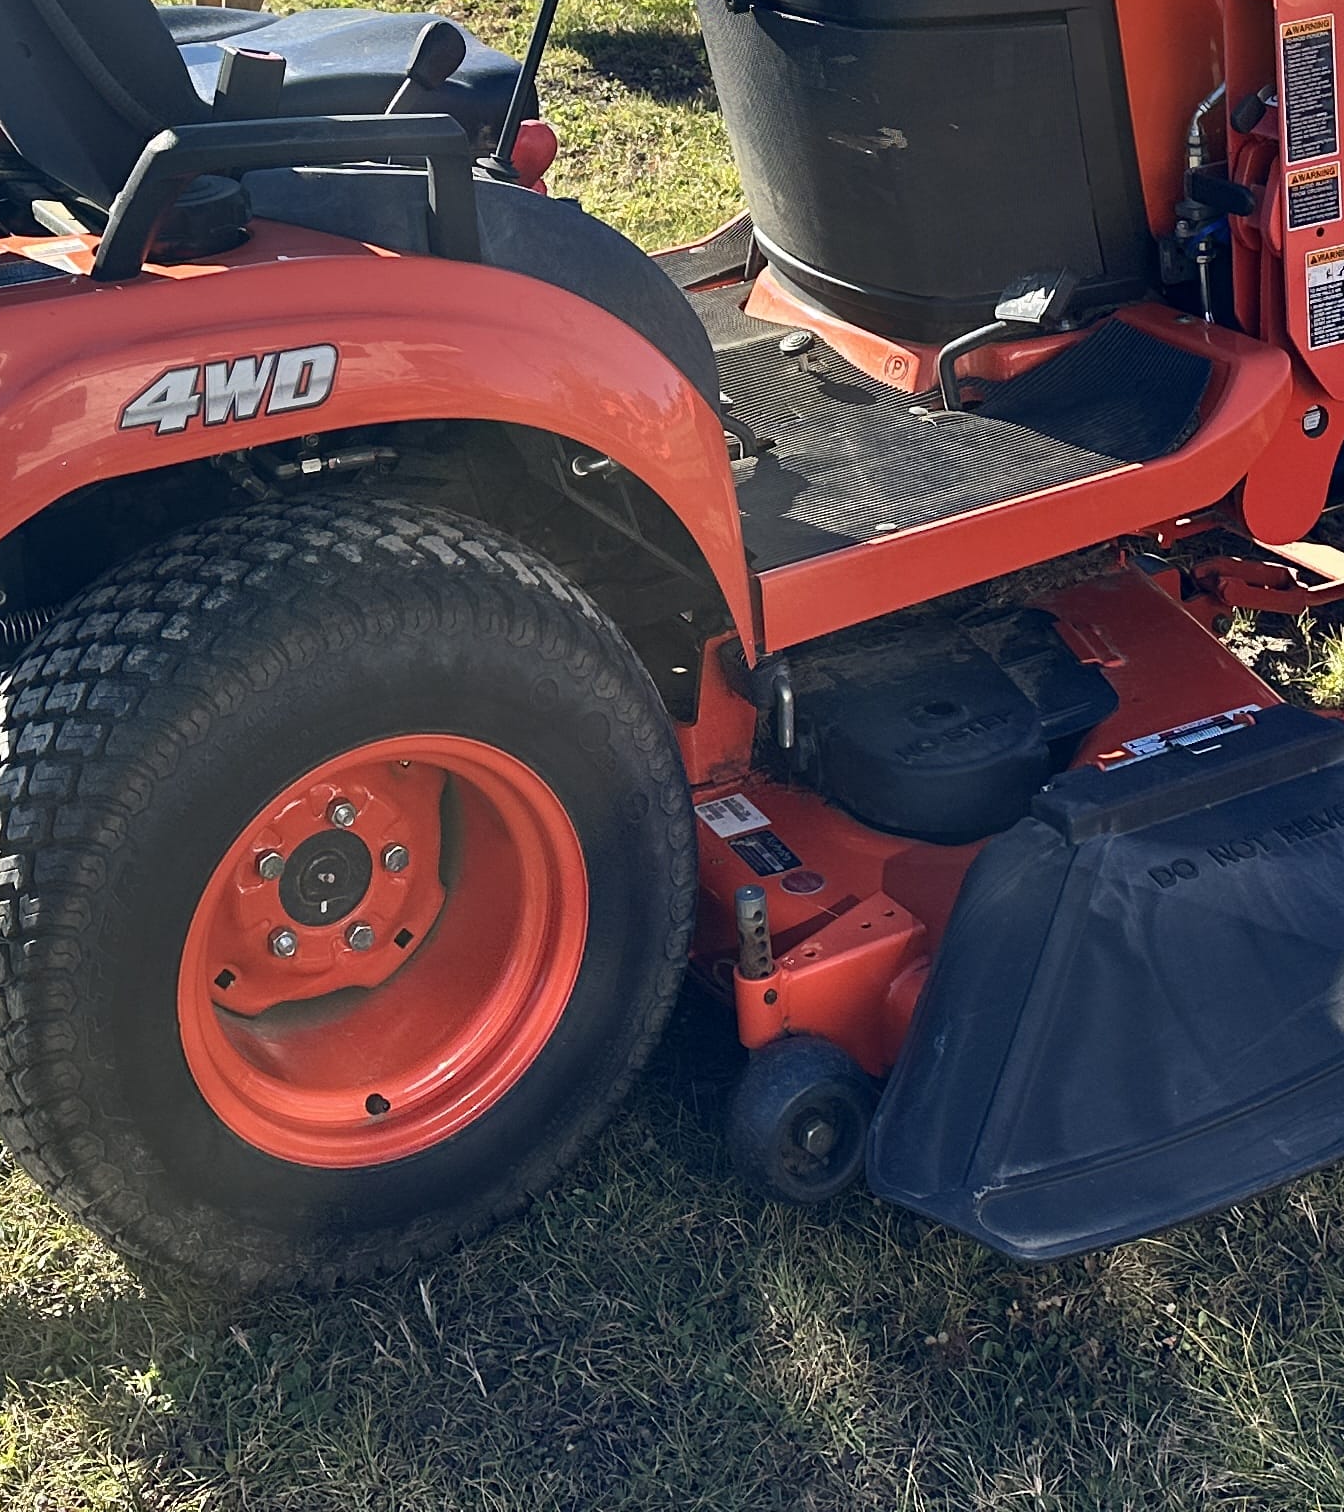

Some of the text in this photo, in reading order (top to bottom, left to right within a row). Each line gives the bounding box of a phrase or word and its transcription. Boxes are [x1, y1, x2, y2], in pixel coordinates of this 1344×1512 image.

[1292, 19, 1330, 34] WARNING
[1298, 167, 1336, 182] WARNING
[118, 343, 339, 436] 4WD
[1147, 858, 1199, 889] DO
[1206, 834, 1271, 868] NOT
